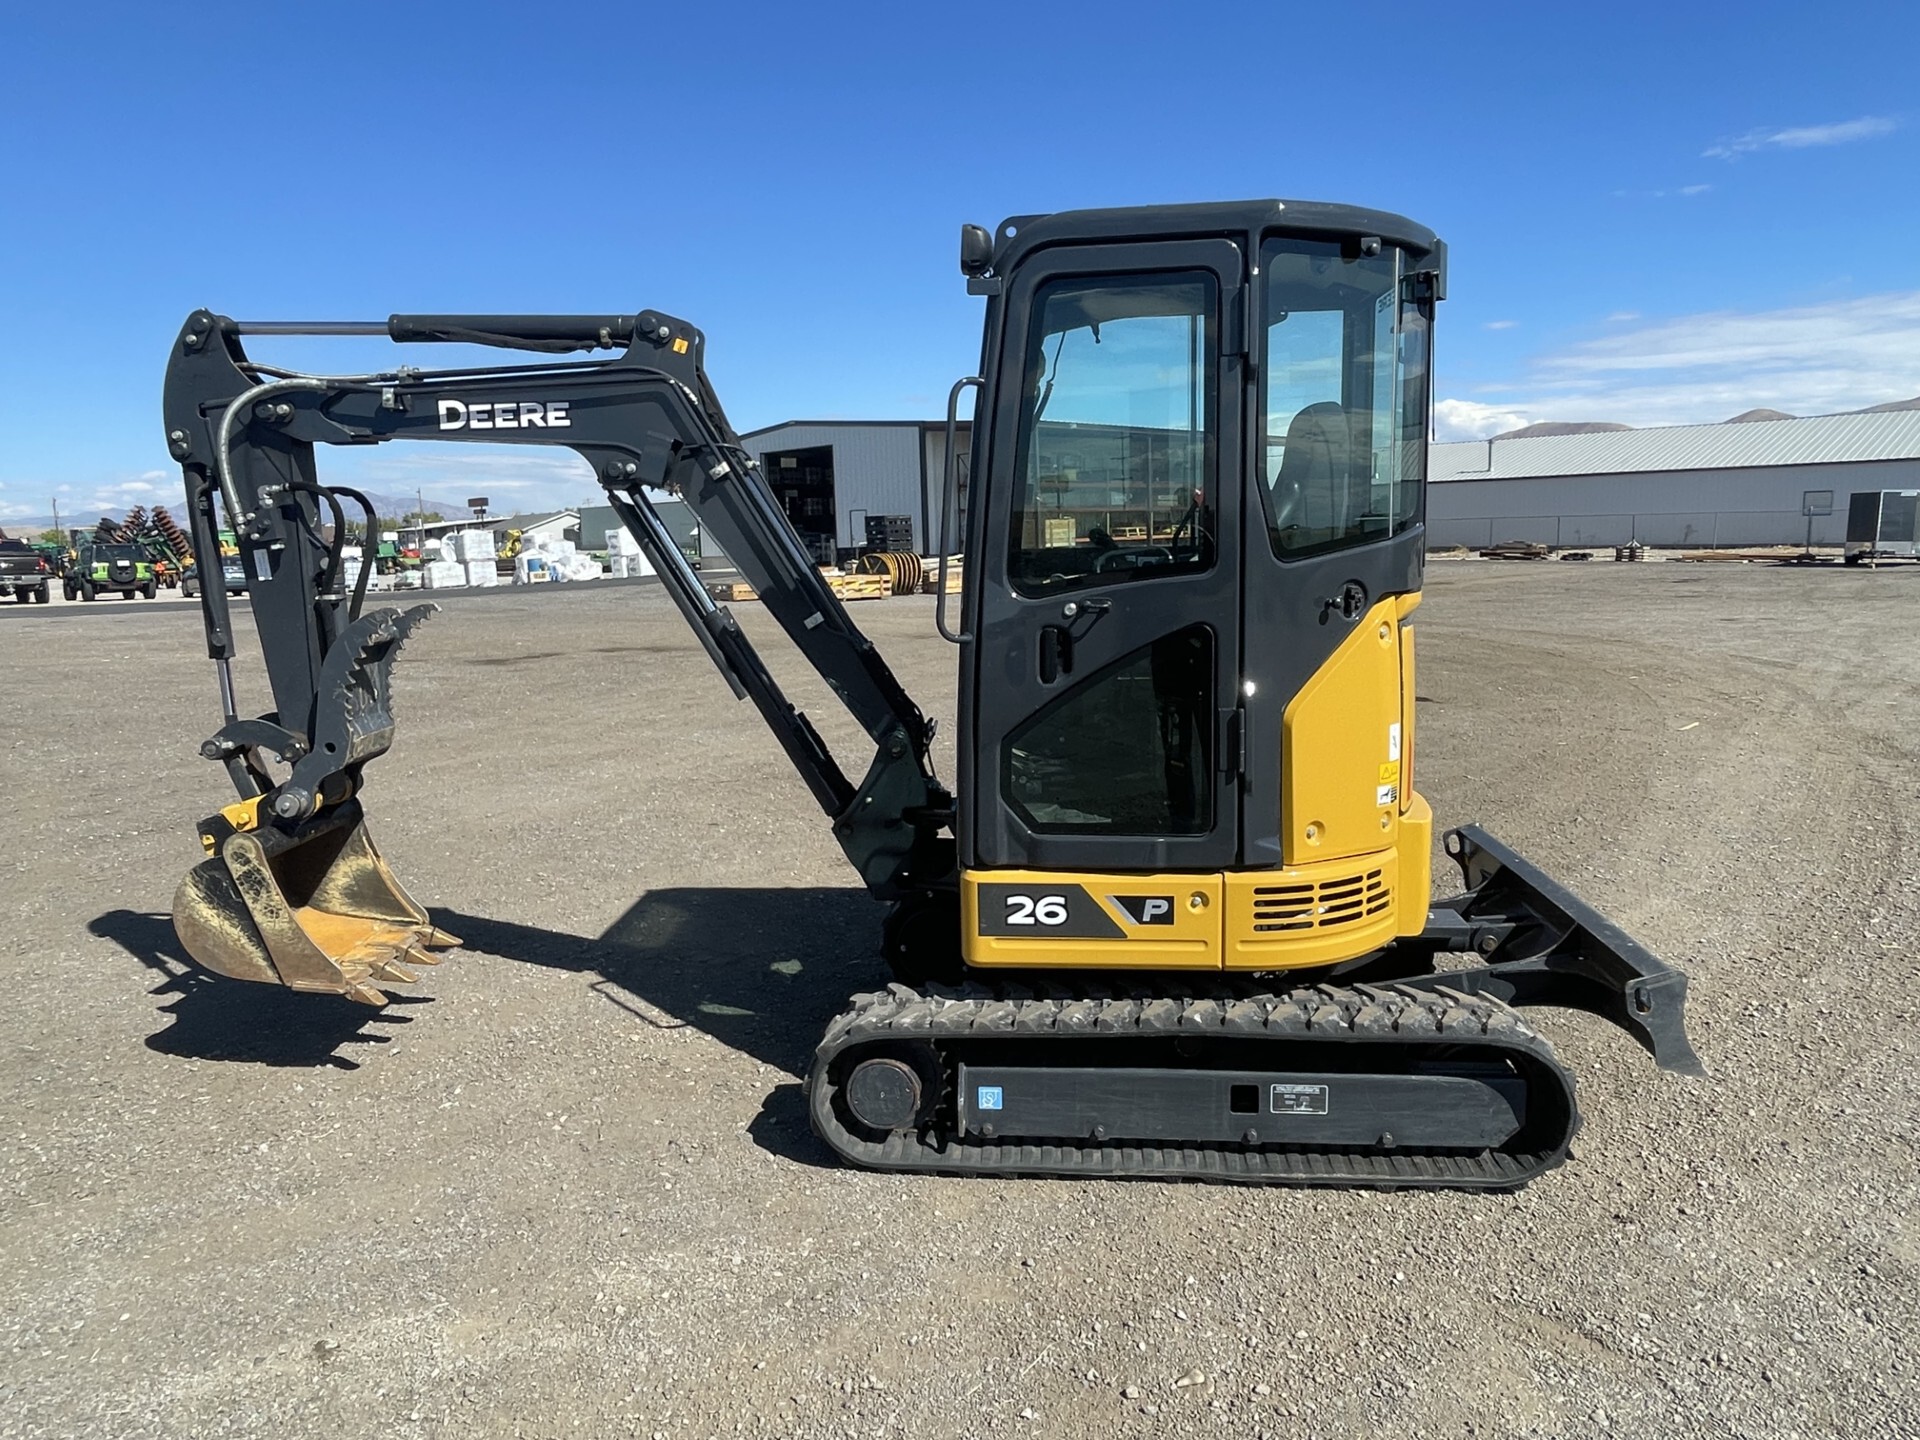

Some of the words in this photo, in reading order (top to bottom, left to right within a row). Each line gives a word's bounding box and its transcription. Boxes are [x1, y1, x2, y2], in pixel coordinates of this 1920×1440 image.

[438, 400, 571, 430] DEERE
[1006, 895, 1068, 925] 26
[1142, 899, 1169, 922] P
